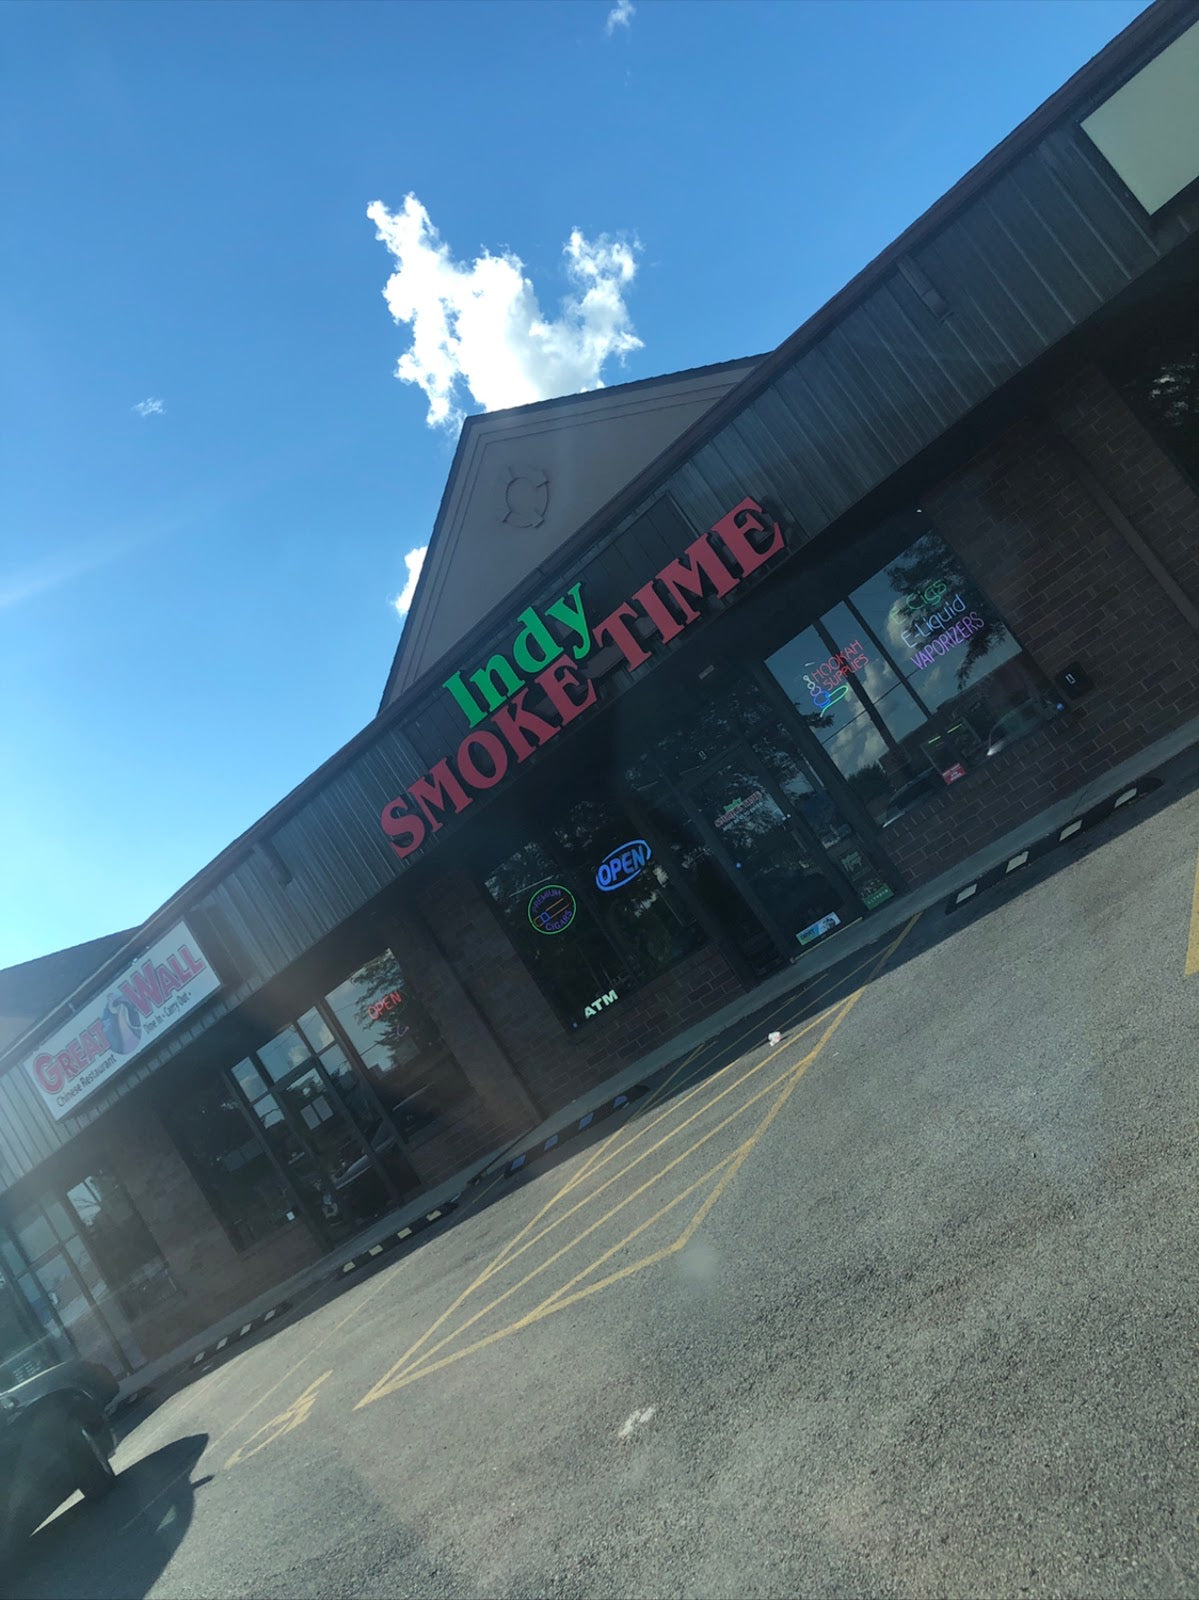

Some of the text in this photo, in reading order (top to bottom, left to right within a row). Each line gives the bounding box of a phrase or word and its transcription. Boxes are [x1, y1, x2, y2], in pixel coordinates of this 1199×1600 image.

[900, 593, 967, 649] E-Liquid
[910, 611, 985, 670] VAPORIZERS
[443, 582, 592, 729] Indy
[811, 639, 865, 682] HOOKAH
[823, 653, 870, 691] SUPPLIES
[380, 496, 785, 859] SMOKE TIME
[597, 845, 647, 886] OPEN
[532, 889, 562, 914] PREMIUM
[545, 910, 573, 931] CIGARS
[33, 943, 207, 1095] GREAT WALL
[367, 991, 402, 1020] OPEN
[584, 989, 619, 1018] ATM
[56, 1053, 118, 1108] Chinese Restaurant
